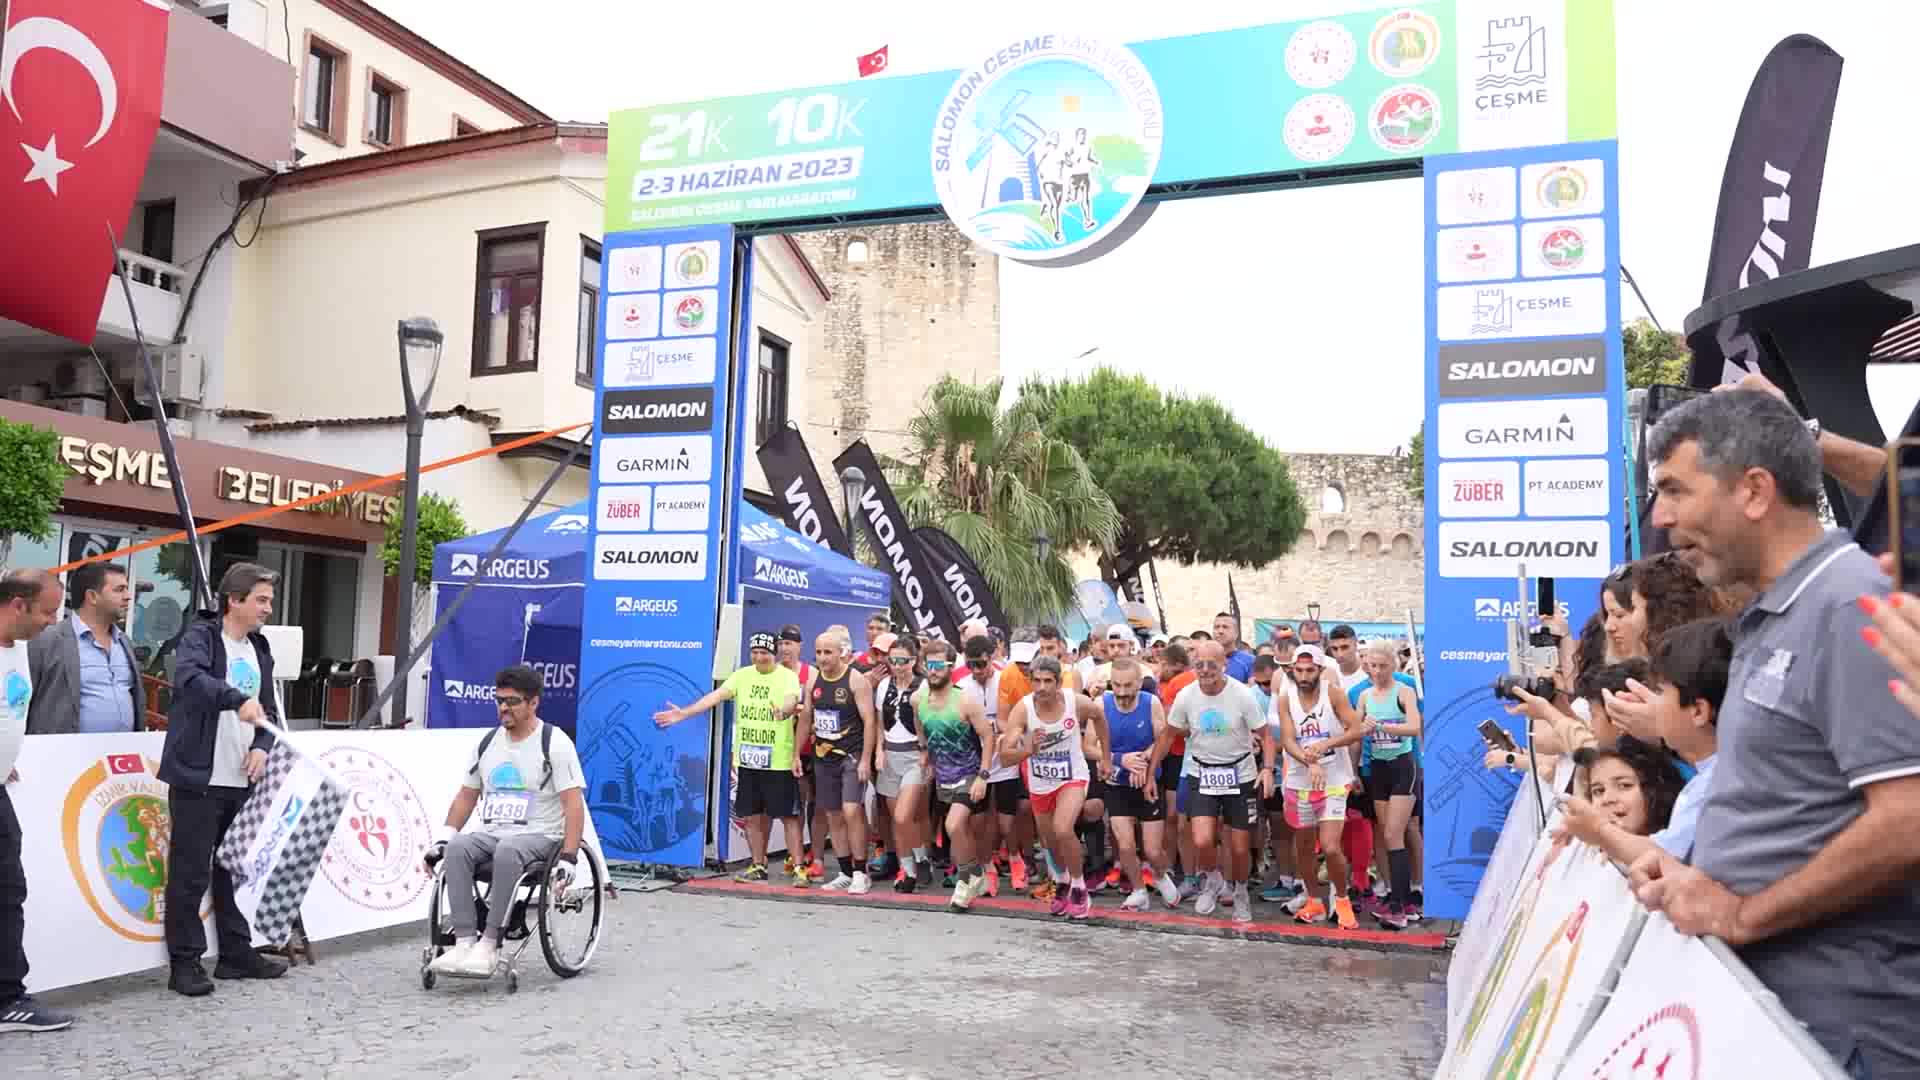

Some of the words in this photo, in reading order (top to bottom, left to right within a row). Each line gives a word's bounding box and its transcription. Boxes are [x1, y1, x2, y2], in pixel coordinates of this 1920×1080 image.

[1474, 89, 1549, 111] ÇEŞME
[767, 93, 869, 147] 10K
[935, 72, 984, 172] SALOMON
[640, 109, 734, 161] 21K
[679, 164, 783, 193] HAZİRAN
[787, 157, 854, 181] 2023
[1448, 357, 1596, 380] SALOMON
[608, 401, 707, 421] SALOMON
[1465, 426, 1575, 444] GARMIN
[57, 436, 173, 488] EŞME
[617, 457, 690, 472] GARMIN
[1528, 481, 1541, 491] PT
[1546, 480, 1603, 490] ACADEMY
[656, 502, 666, 510] PT
[668, 501, 705, 510] ACADEMY
[601, 550, 699, 564] SALOMON
[1450, 541, 1598, 557] SALOMON
[767, 563, 809, 588] ARGEUS
[632, 599, 678, 612] ARGEUS
[1035, 765, 1066, 777] 1501
[1203, 773, 1234, 785] 1808
[487, 803, 524, 818] 1438
